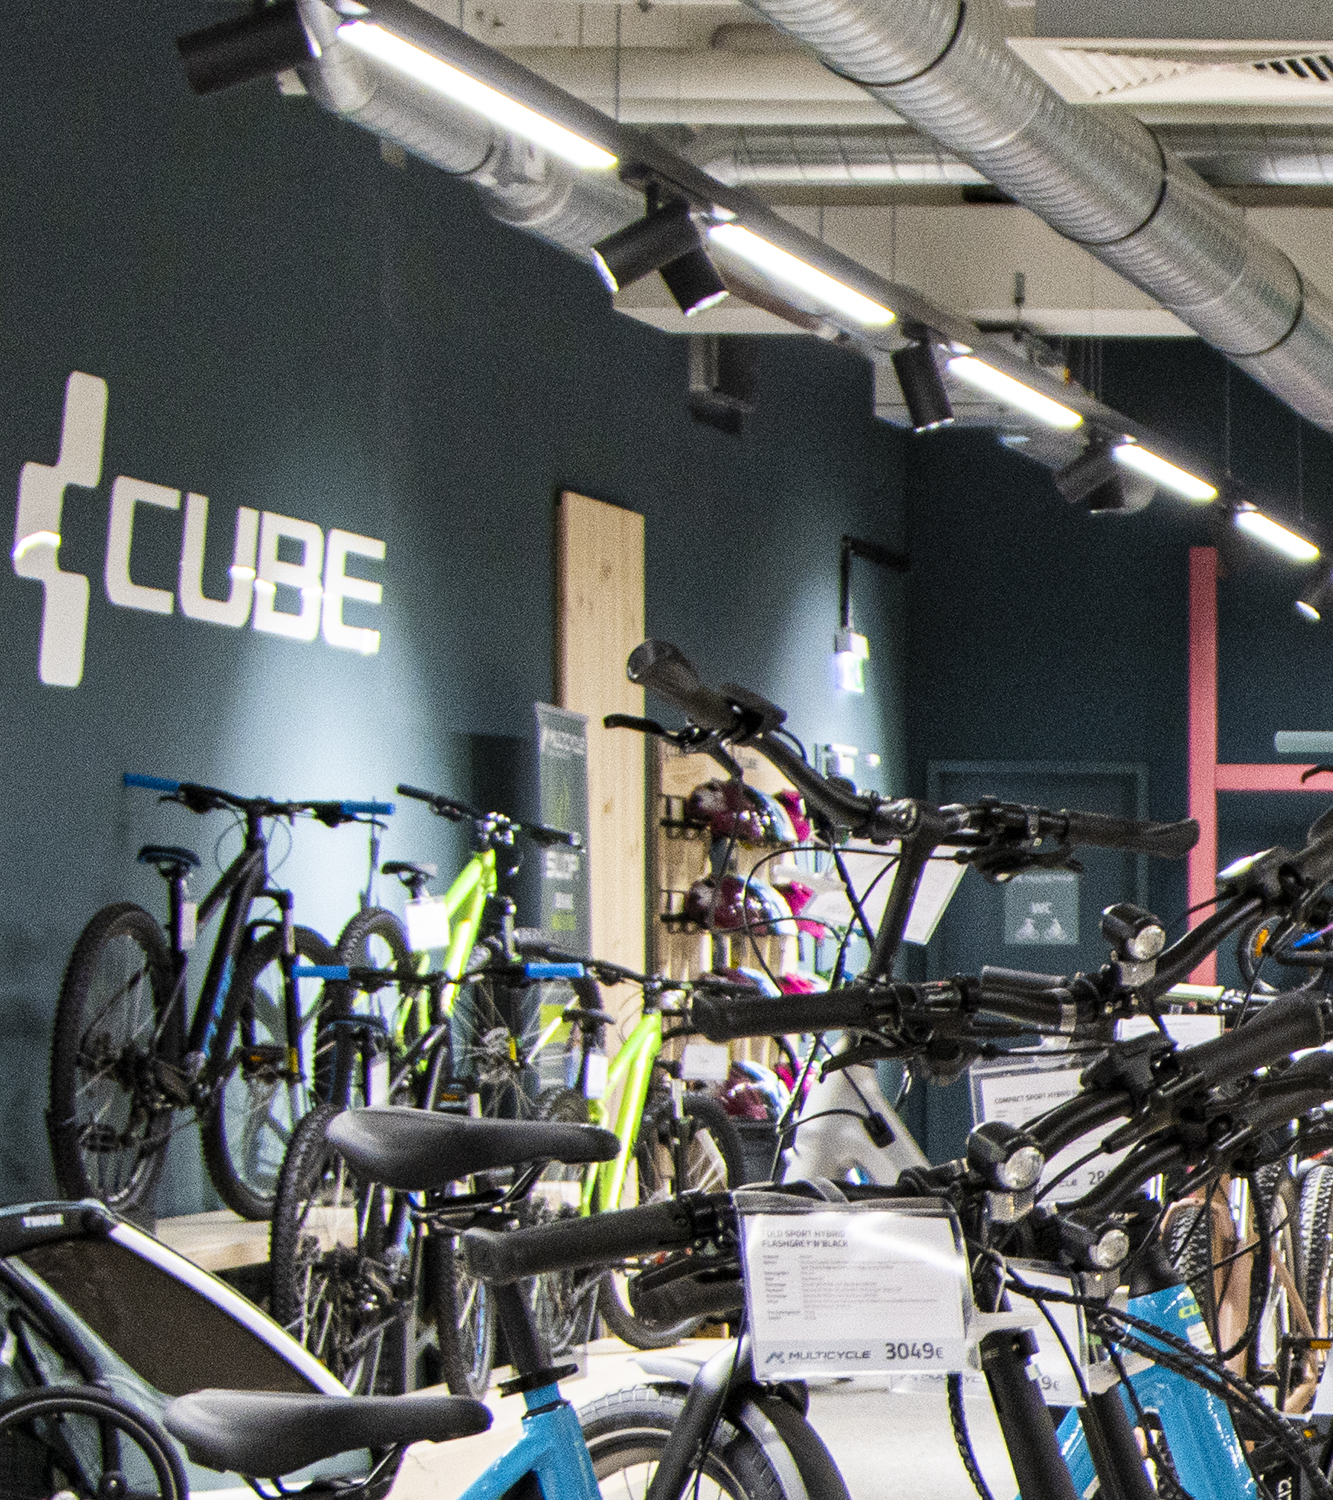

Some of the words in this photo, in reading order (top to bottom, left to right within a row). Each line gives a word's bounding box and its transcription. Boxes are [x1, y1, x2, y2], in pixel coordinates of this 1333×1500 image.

[105, 475, 387, 655] CUBE
[788, 1349, 871, 1361] MULTICYCLE
[885, 1342, 945, 1361] 3049€
